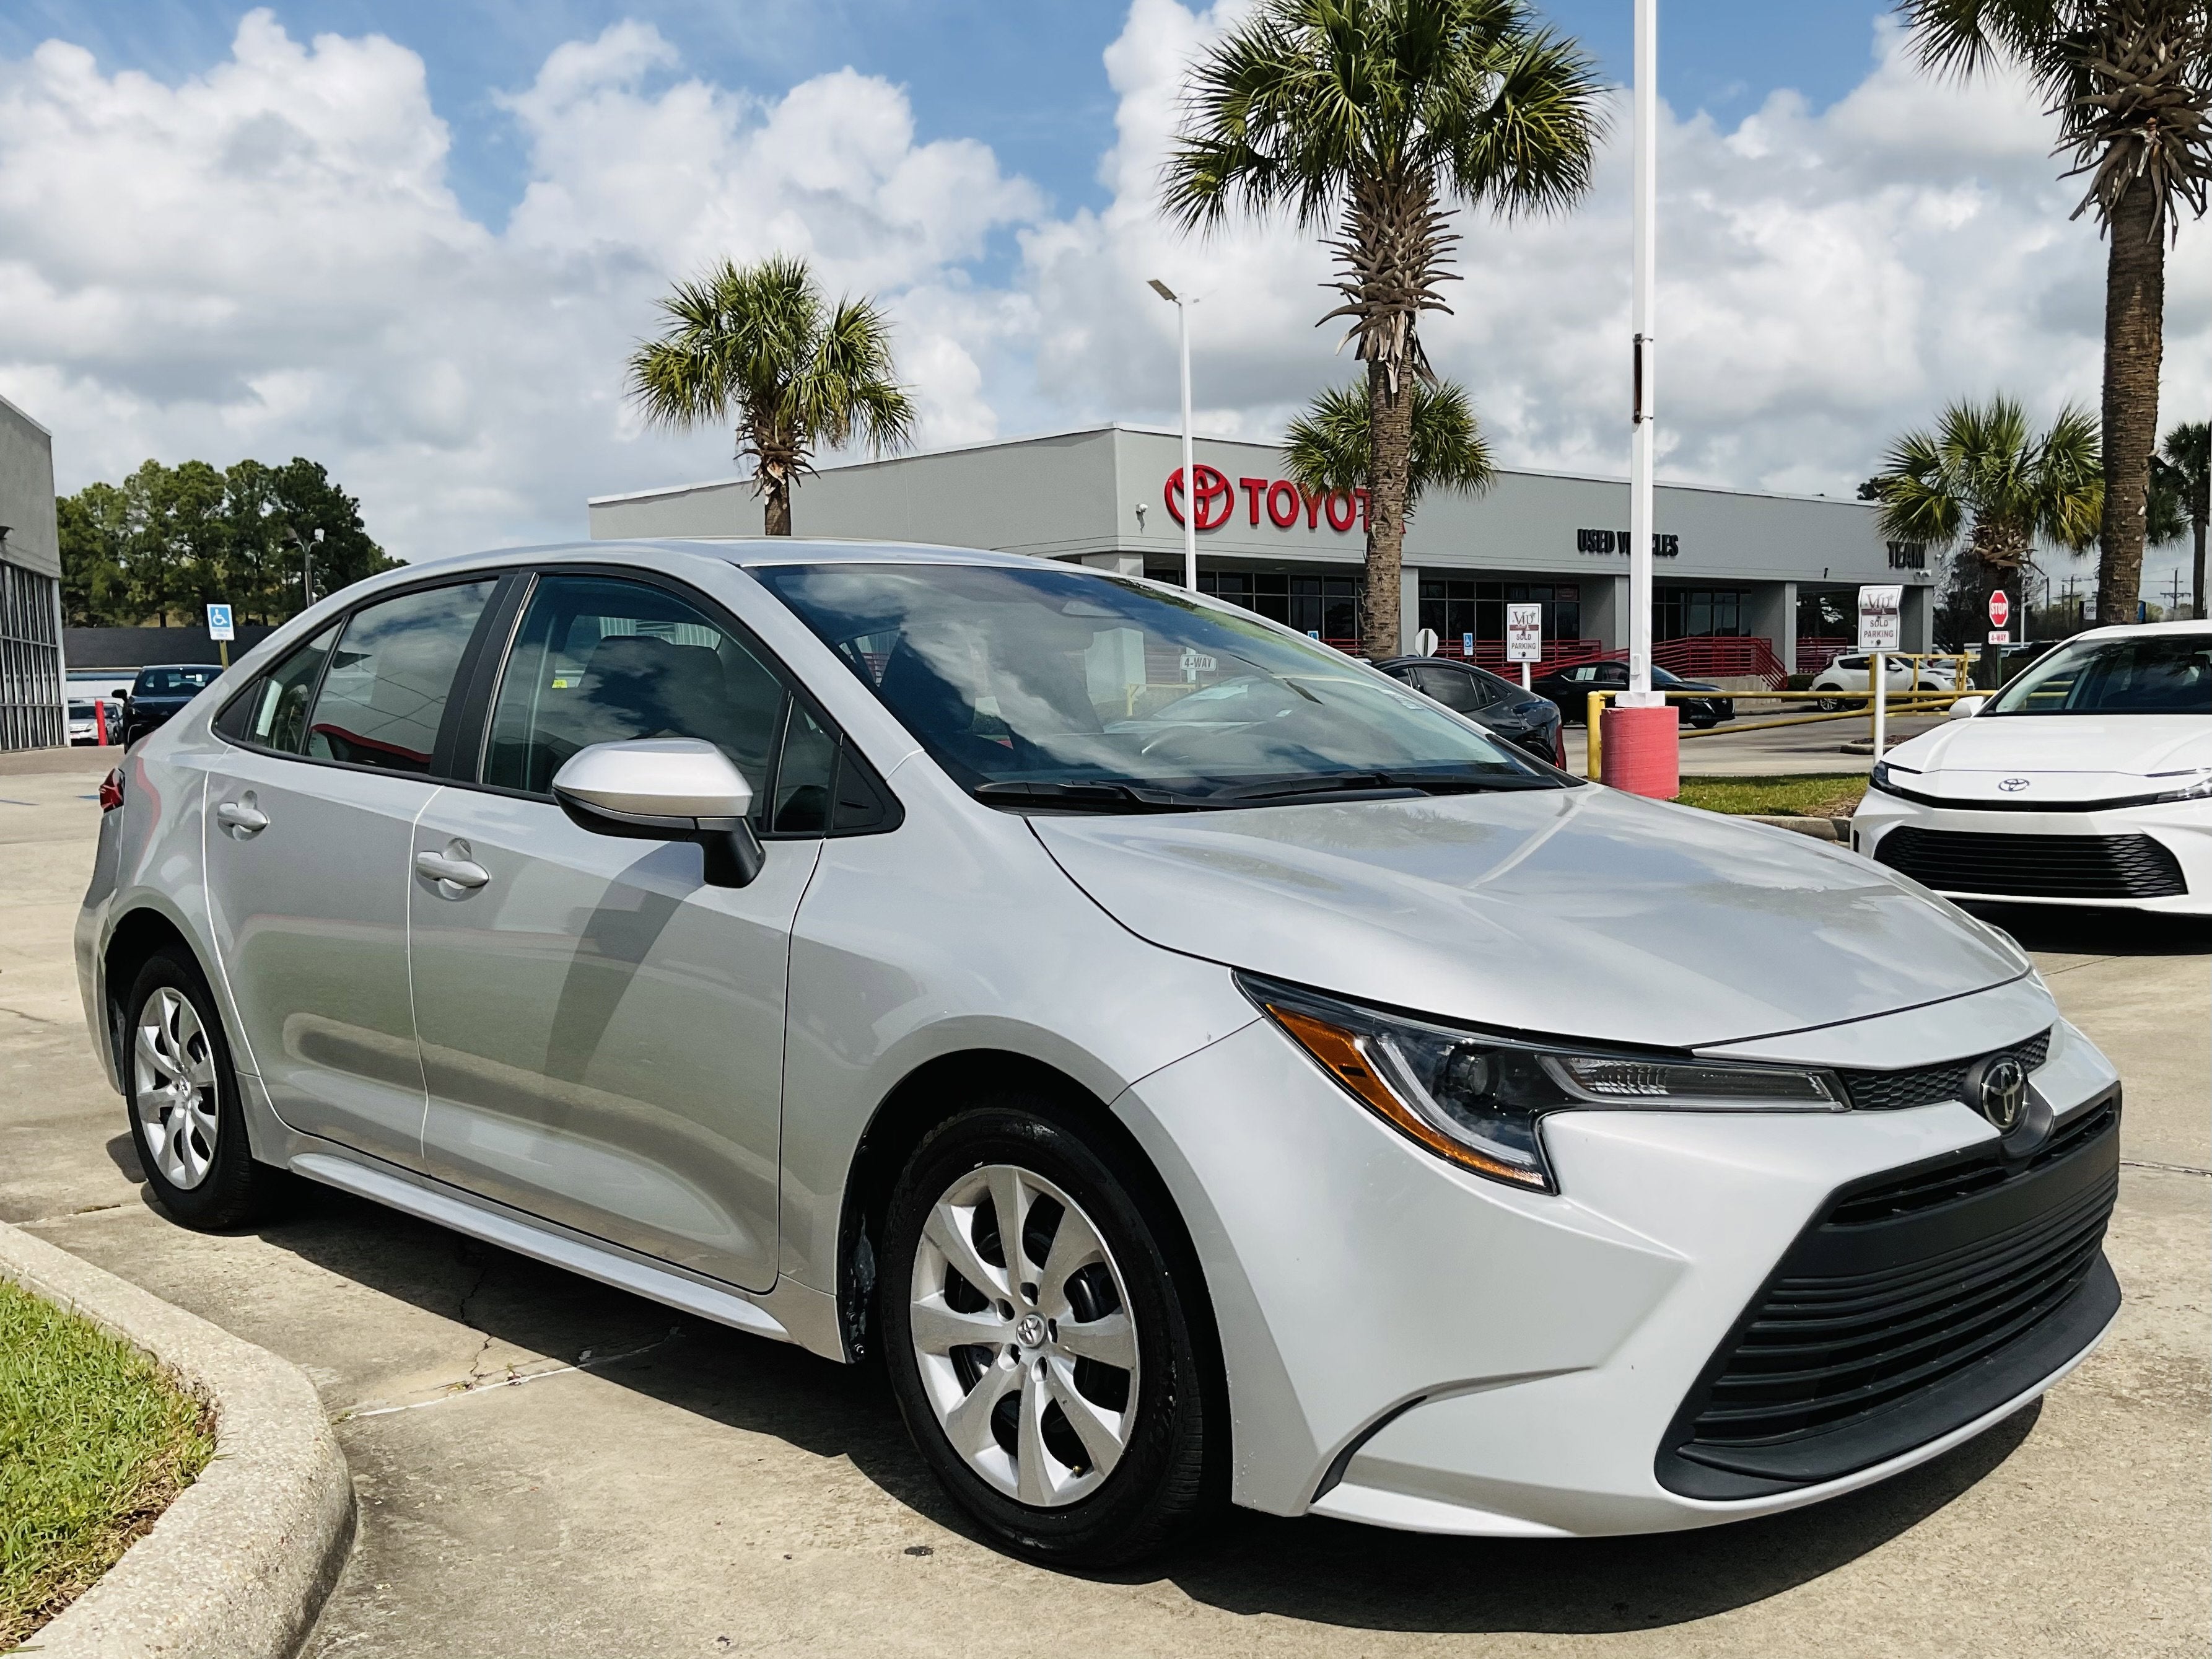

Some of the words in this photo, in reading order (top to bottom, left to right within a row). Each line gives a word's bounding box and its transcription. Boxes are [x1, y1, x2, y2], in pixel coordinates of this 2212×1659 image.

[1240, 477, 1405, 533] TOYOT
[1577, 528, 1615, 553] USED
[1887, 541, 1926, 569] TEAM
[1991, 602, 2006, 615] STOP
[1869, 619, 1889, 628] SOLD
[1863, 630, 1894, 638] PARKING
[1991, 634, 2006, 642] 4-WAY
[1184, 657, 1212, 668] 4-WAY
